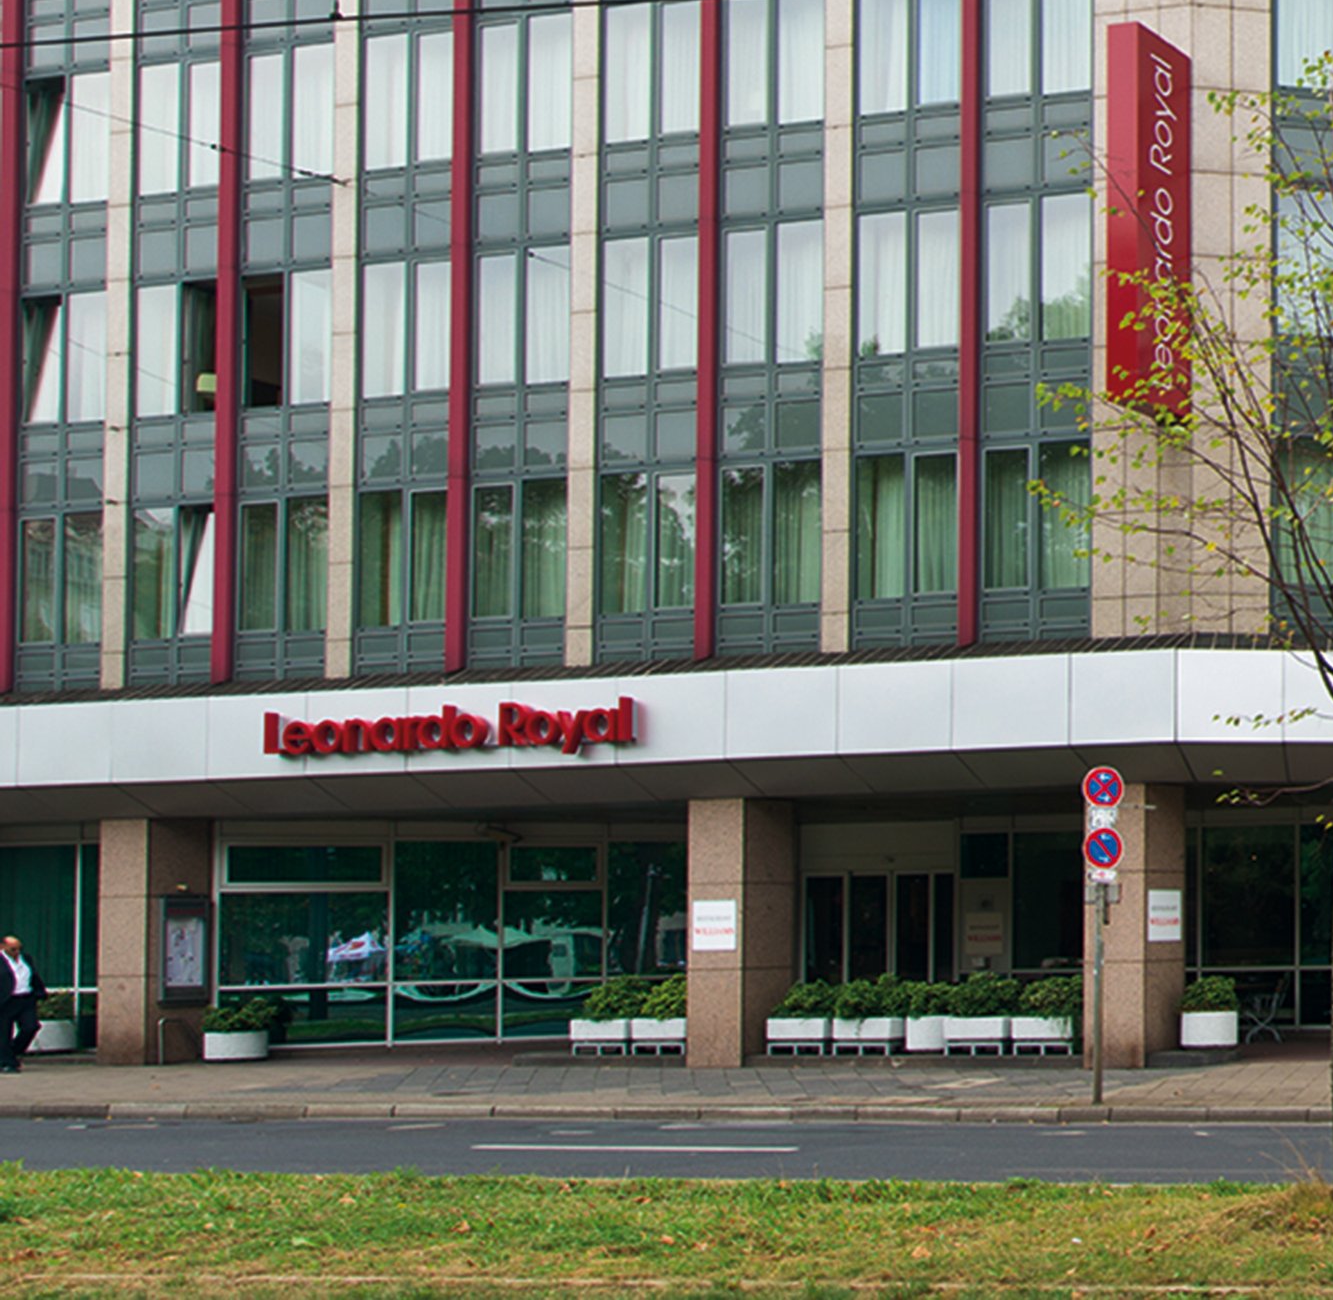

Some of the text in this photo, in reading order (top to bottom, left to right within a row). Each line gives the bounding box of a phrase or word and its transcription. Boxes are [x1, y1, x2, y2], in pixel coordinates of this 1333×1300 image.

[1149, 53, 1177, 176] Royal
[263, 695, 638, 755] Leonardo Royal
